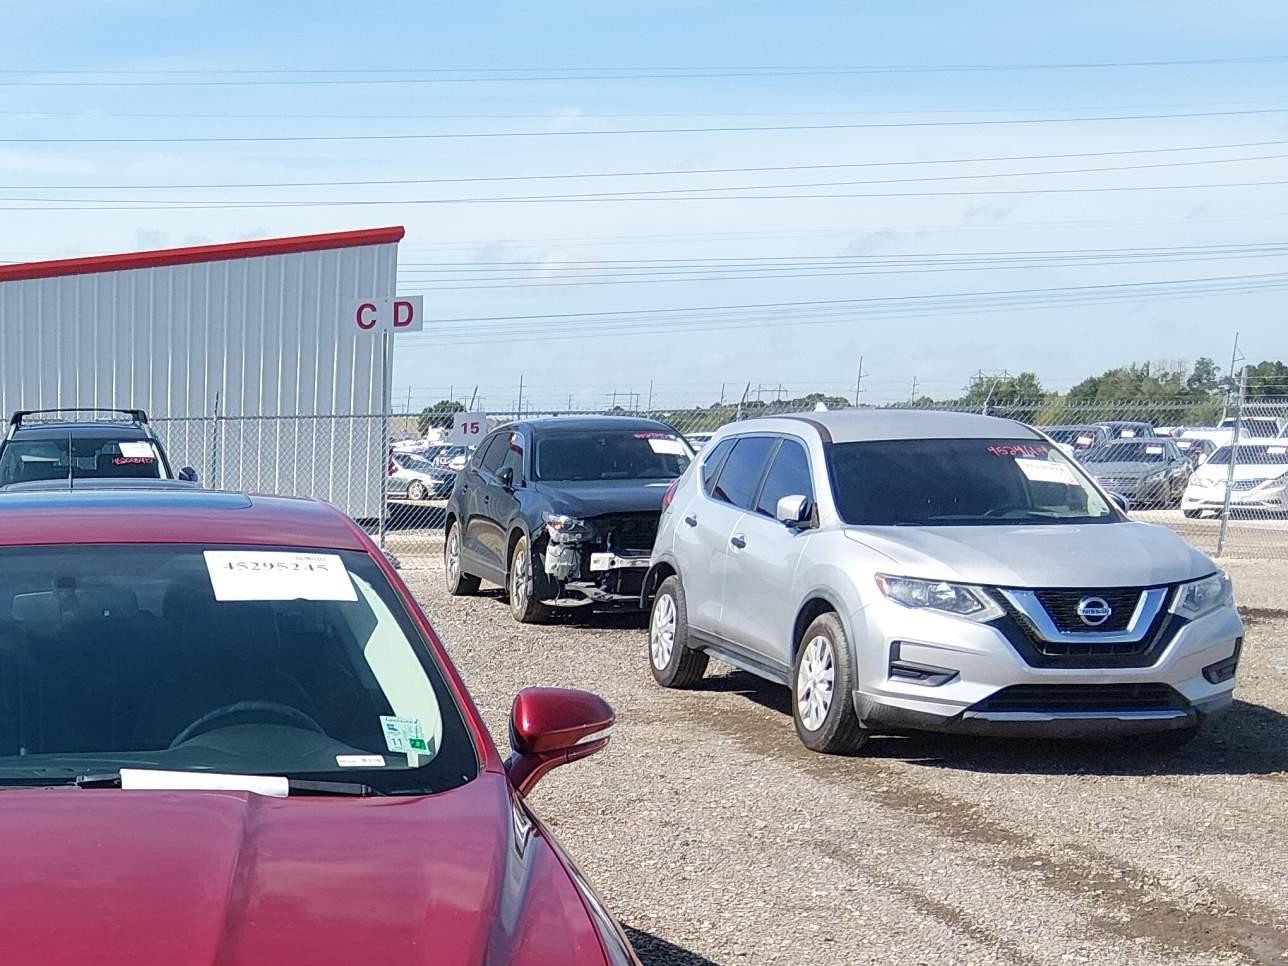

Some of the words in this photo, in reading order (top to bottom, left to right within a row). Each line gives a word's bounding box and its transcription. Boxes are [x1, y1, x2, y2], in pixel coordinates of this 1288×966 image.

[356, 303, 377, 330] C
[393, 301, 414, 327] D
[461, 422, 479, 434] 15
